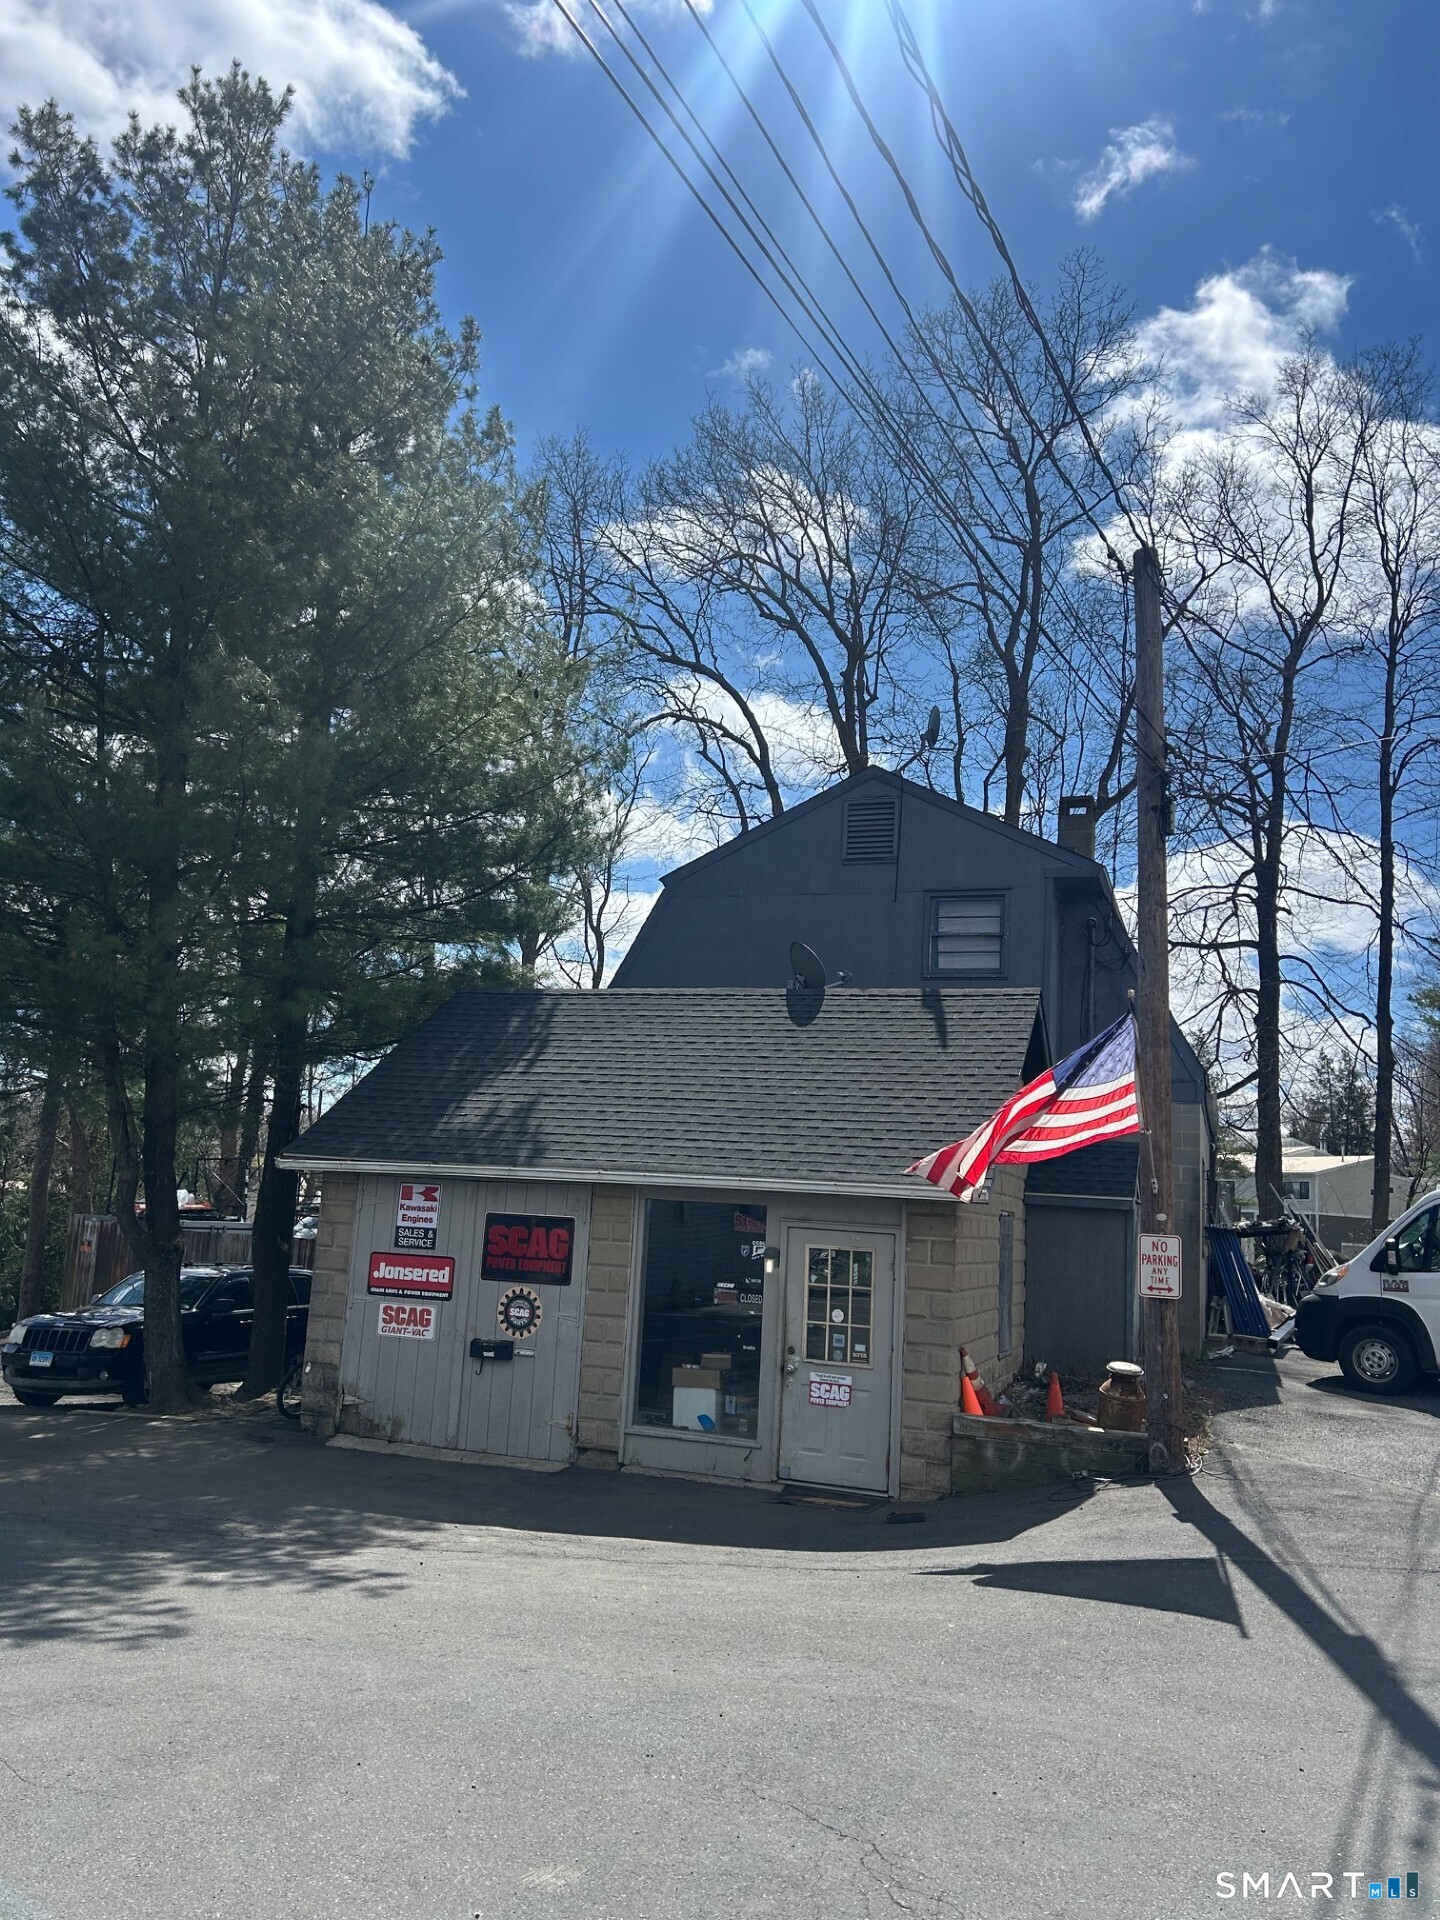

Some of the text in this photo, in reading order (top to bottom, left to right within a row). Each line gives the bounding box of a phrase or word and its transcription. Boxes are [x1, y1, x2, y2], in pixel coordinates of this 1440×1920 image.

[399, 1203, 437, 1212] Kawasaki
[401, 1214, 433, 1224] Engines
[398, 1228, 434, 1239] SALES &
[398, 1237, 434, 1248] SERVICE
[487, 1225, 569, 1260] SCAG
[1152, 1241, 1168, 1253] NO
[486, 1256, 567, 1274] POWER EQUIPMENT
[1141, 1254, 1178, 1267] PARKING
[373, 1262, 450, 1283] Jonsered
[1151, 1267, 1168, 1275] ANY
[1150, 1276, 1170, 1285] TIME
[740, 1293, 763, 1304] CLOSED
[382, 1305, 432, 1328] SCAG
[509, 1307, 530, 1318] SCAG
[381, 1325, 430, 1337] GIANT-VAC
[810, 1383, 850, 1401] SCAG
[810, 1397, 825, 1405] POWER
